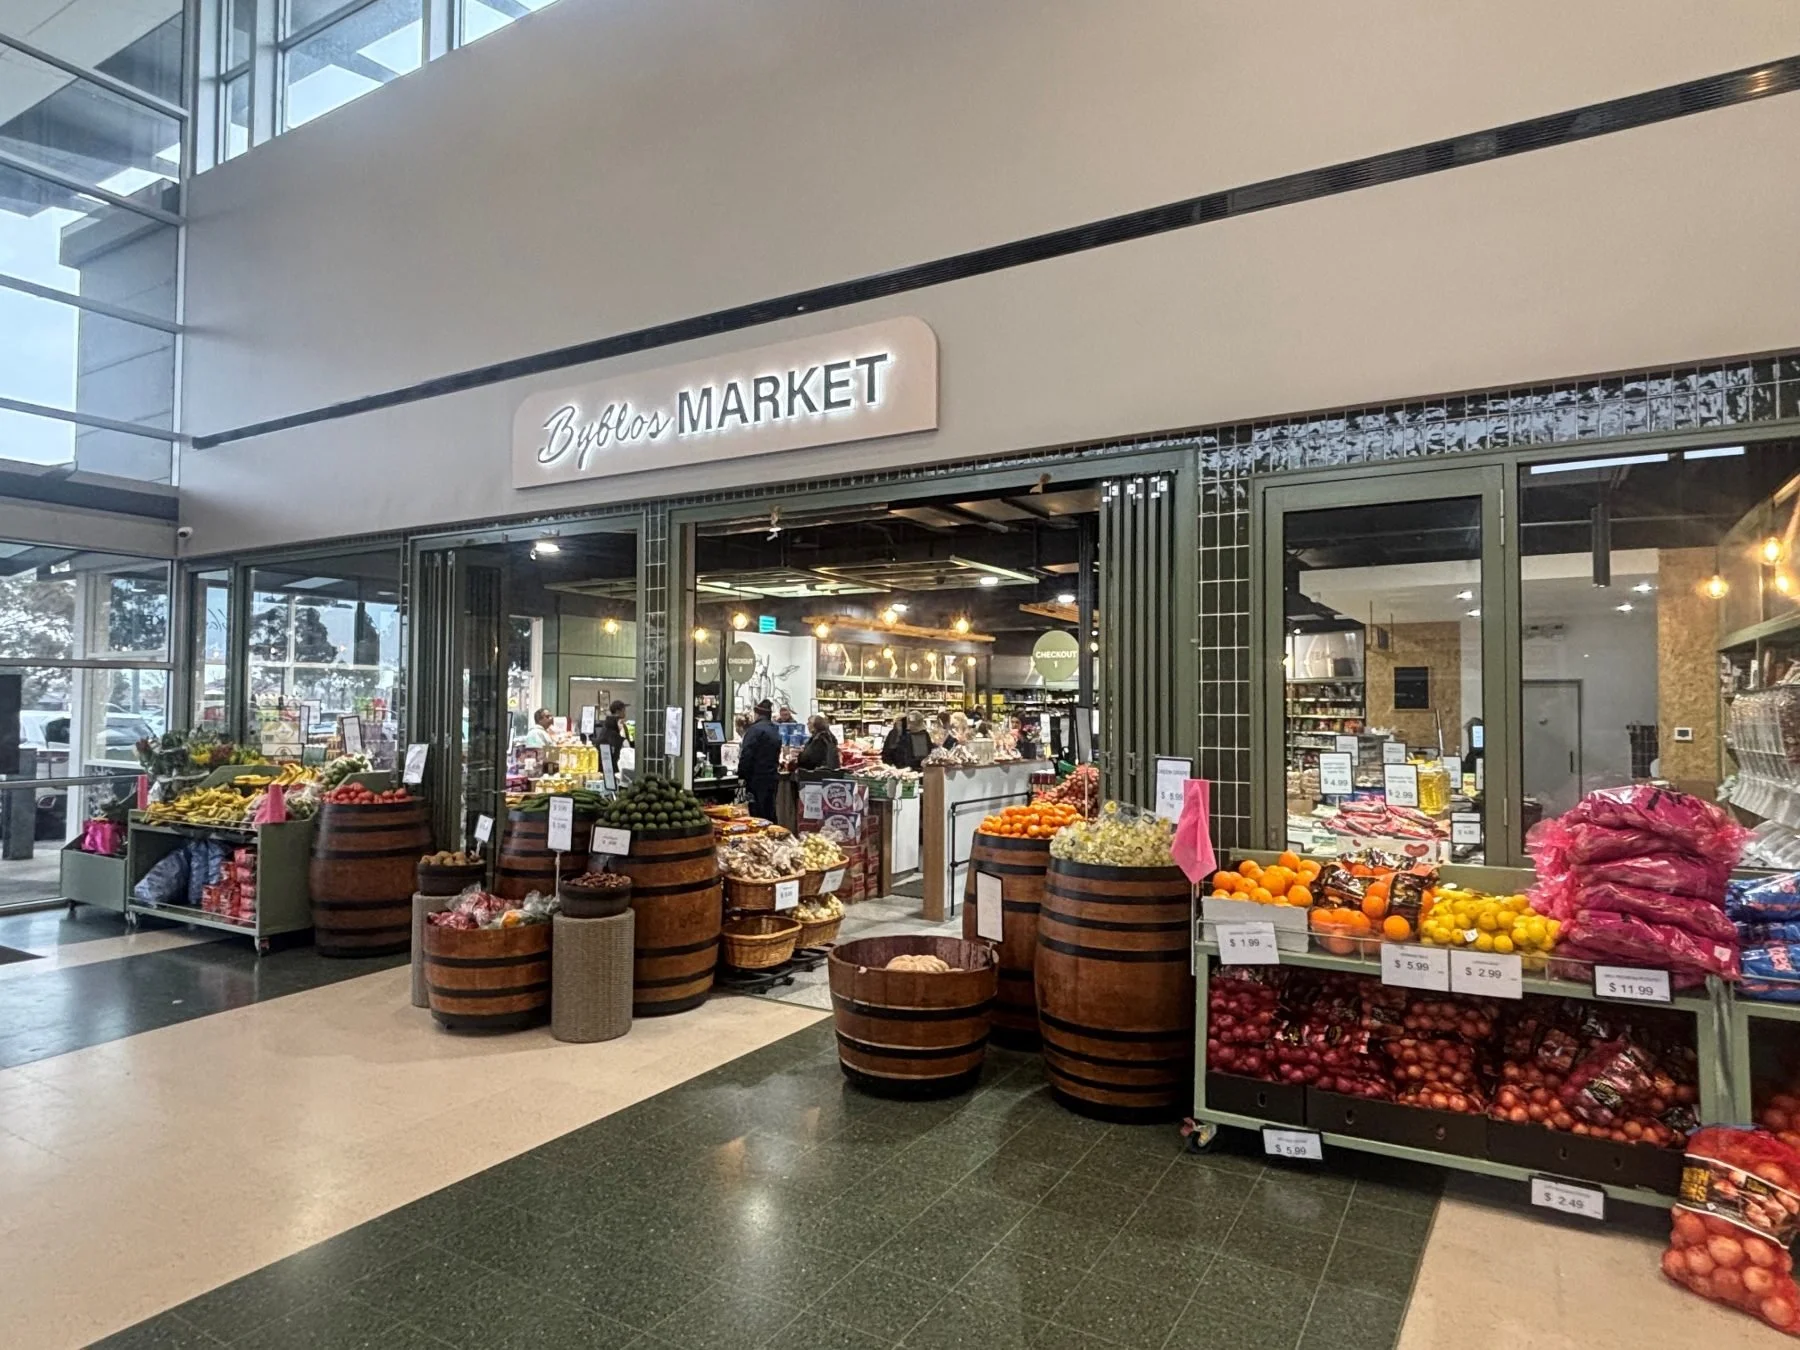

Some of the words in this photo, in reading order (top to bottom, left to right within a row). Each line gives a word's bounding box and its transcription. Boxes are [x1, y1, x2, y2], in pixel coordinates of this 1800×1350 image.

[538, 402, 671, 470] Byblos
[678, 353, 888, 435] MARKET
[1035, 650, 1078, 659] CHECKOUT
[1054, 660, 1059, 669] 1
[1395, 791, 1414, 799] 2.99
[1229, 938, 1236, 948] $
[1394, 959, 1401, 969] $
[1407, 961, 1430, 971] 5.99
[1465, 967, 1473, 976] $
[1478, 968, 1502, 979] 2.99
[1609, 982, 1617, 993] $
[1621, 984, 1654, 996] 11.99
[1275, 1144, 1282, 1153] $
[1286, 1146, 1306, 1156] 5.99
[1544, 1192, 1552, 1202] $
[1558, 1196, 1584, 1209] 2.49
